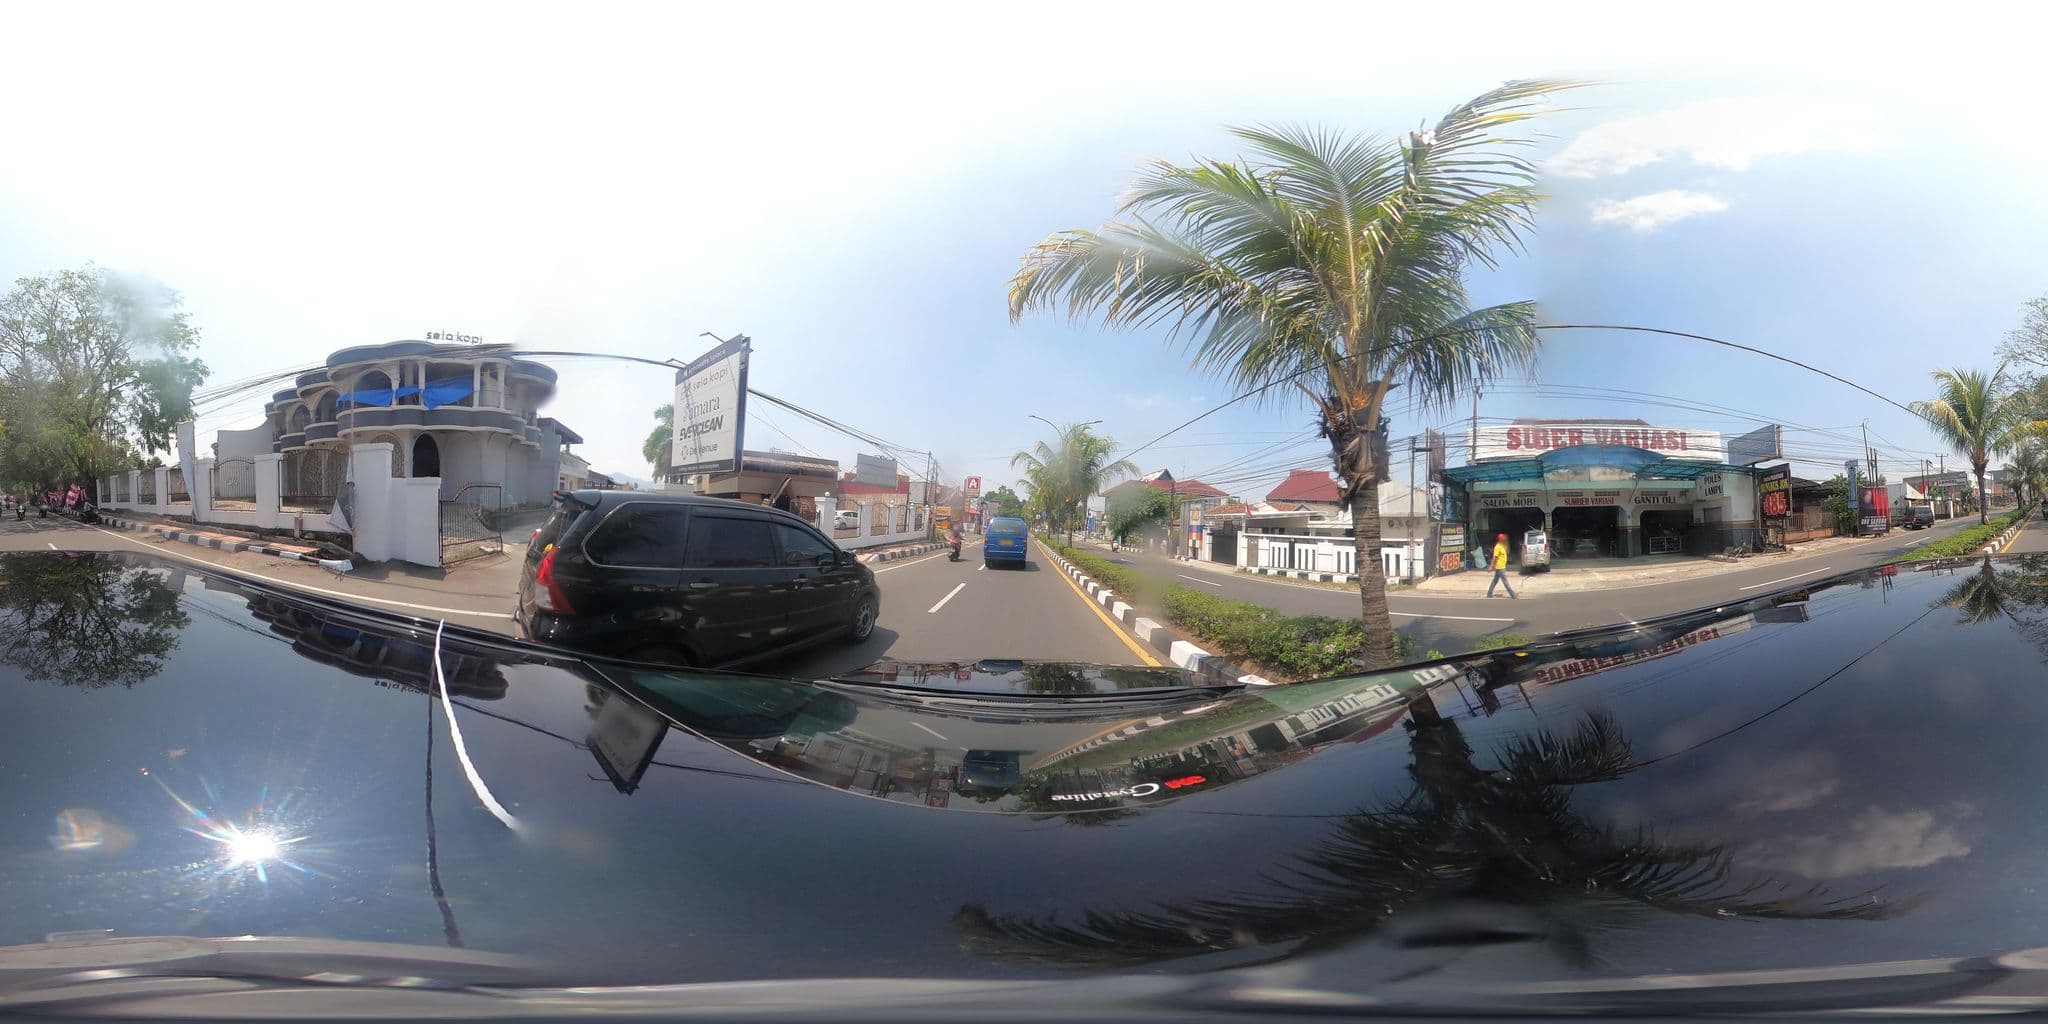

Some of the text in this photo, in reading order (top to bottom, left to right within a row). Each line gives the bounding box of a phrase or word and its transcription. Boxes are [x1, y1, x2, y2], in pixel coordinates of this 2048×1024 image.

[426, 328, 483, 345] sela kopi
[692, 364, 728, 391] sela kopi
[679, 414, 724, 441] EVERCLEAN
[1593, 428, 1687, 451] VARIASI
[1703, 473, 1722, 485] POLES
[1482, 498, 1512, 508] SALON
[1564, 496, 1614, 505] SUMBER VARIASI
[1634, 496, 1659, 505] GANTI
[1763, 491, 1786, 516] 485
[1440, 552, 1460, 571] 485
[1051, 783, 1160, 802] Crystalline
